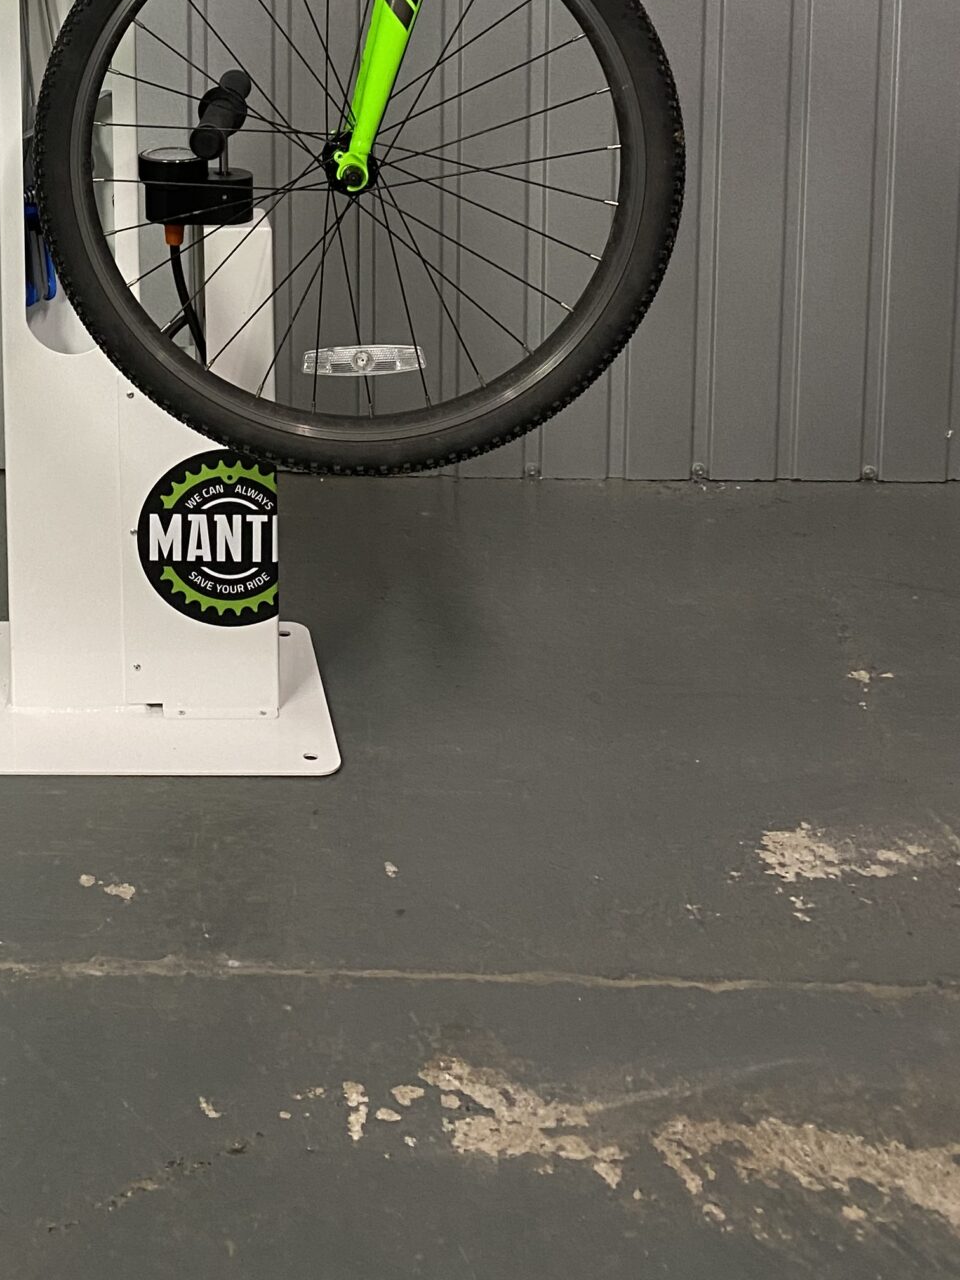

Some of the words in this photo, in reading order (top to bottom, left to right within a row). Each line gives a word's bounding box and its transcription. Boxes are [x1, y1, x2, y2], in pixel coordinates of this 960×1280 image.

[185, 493, 203, 509] WE
[202, 484, 224, 498] CAN
[234, 484, 274, 510] ALWAYS
[188, 571, 215, 591] SAVE
[216, 583, 245, 594] YOUR
[246, 571, 270, 591] RIDE
